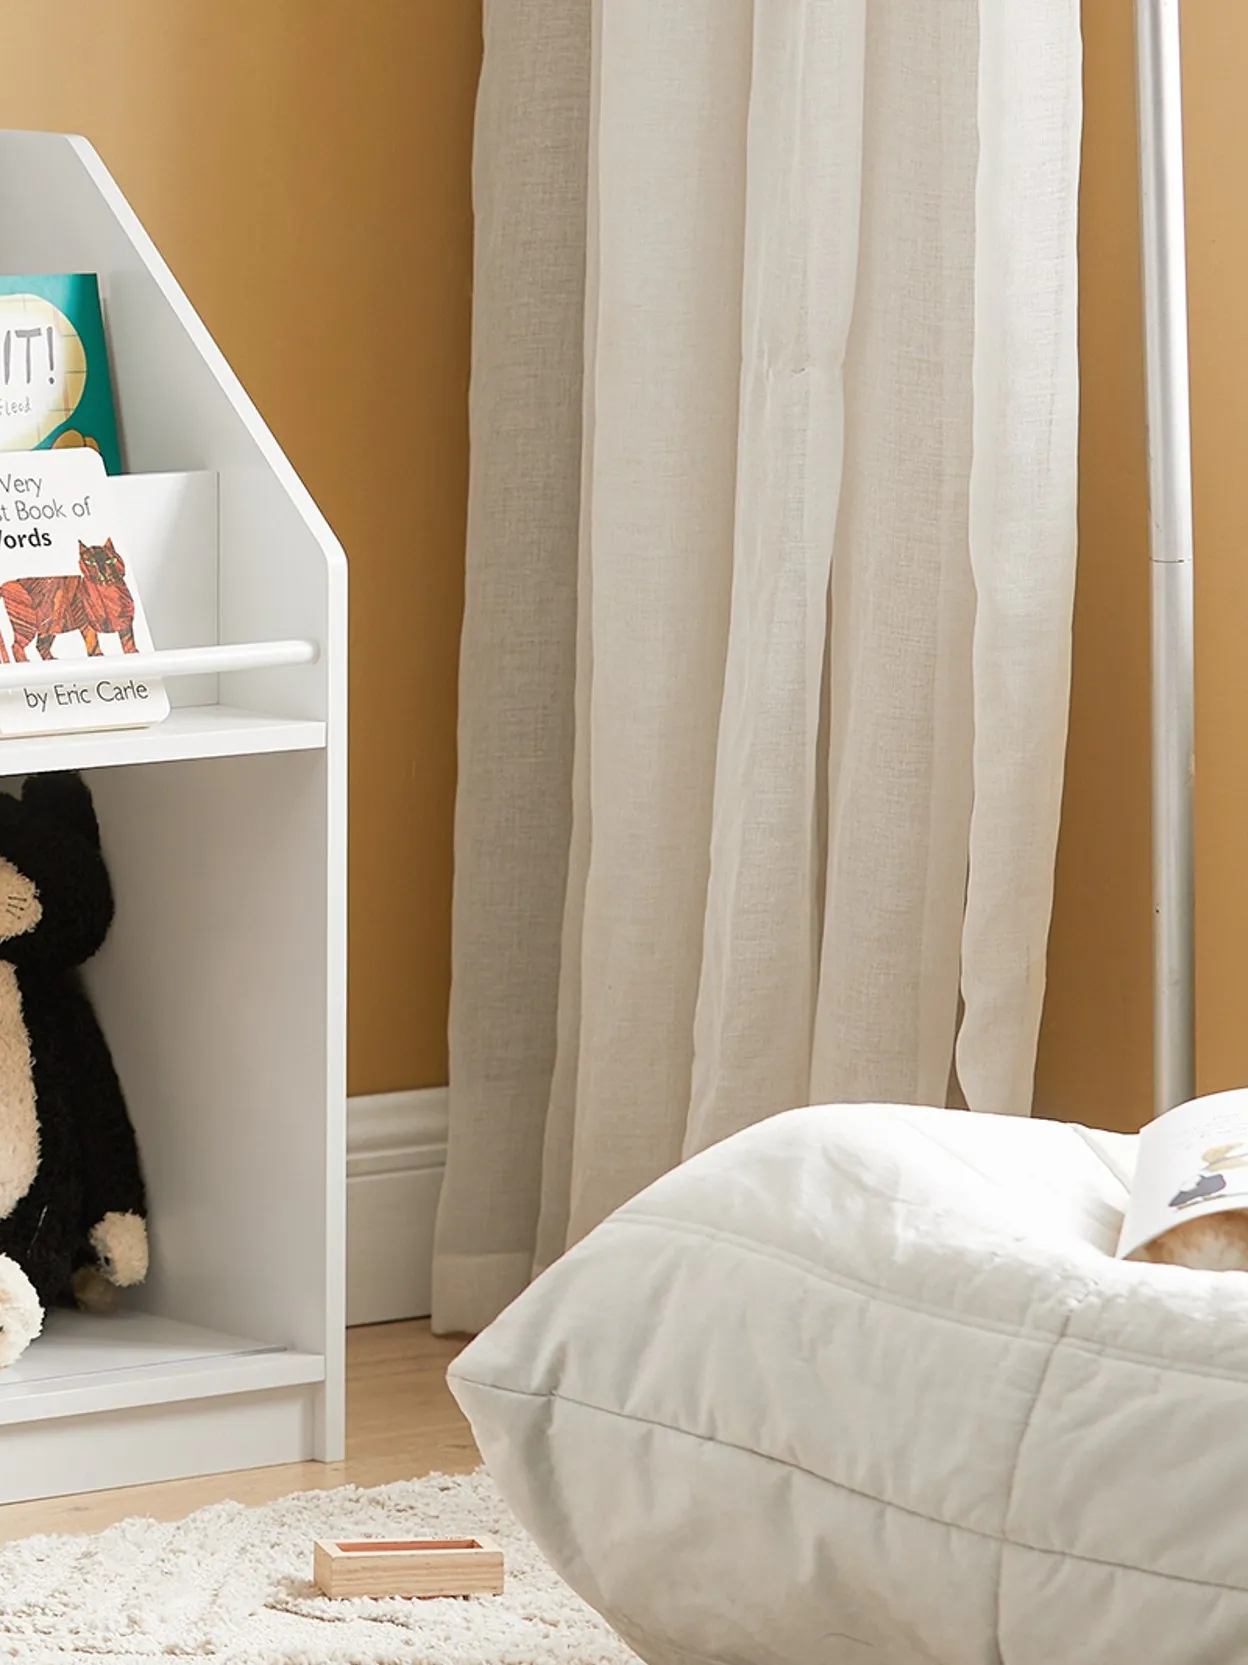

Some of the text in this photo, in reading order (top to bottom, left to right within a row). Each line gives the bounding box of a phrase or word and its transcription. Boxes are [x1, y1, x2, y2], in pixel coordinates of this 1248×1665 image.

[2, 326, 56, 385] IT!
[15, 498, 68, 521] Book
[72, 495, 92, 517] of
[24, 679, 149, 712] by Eric Carle
